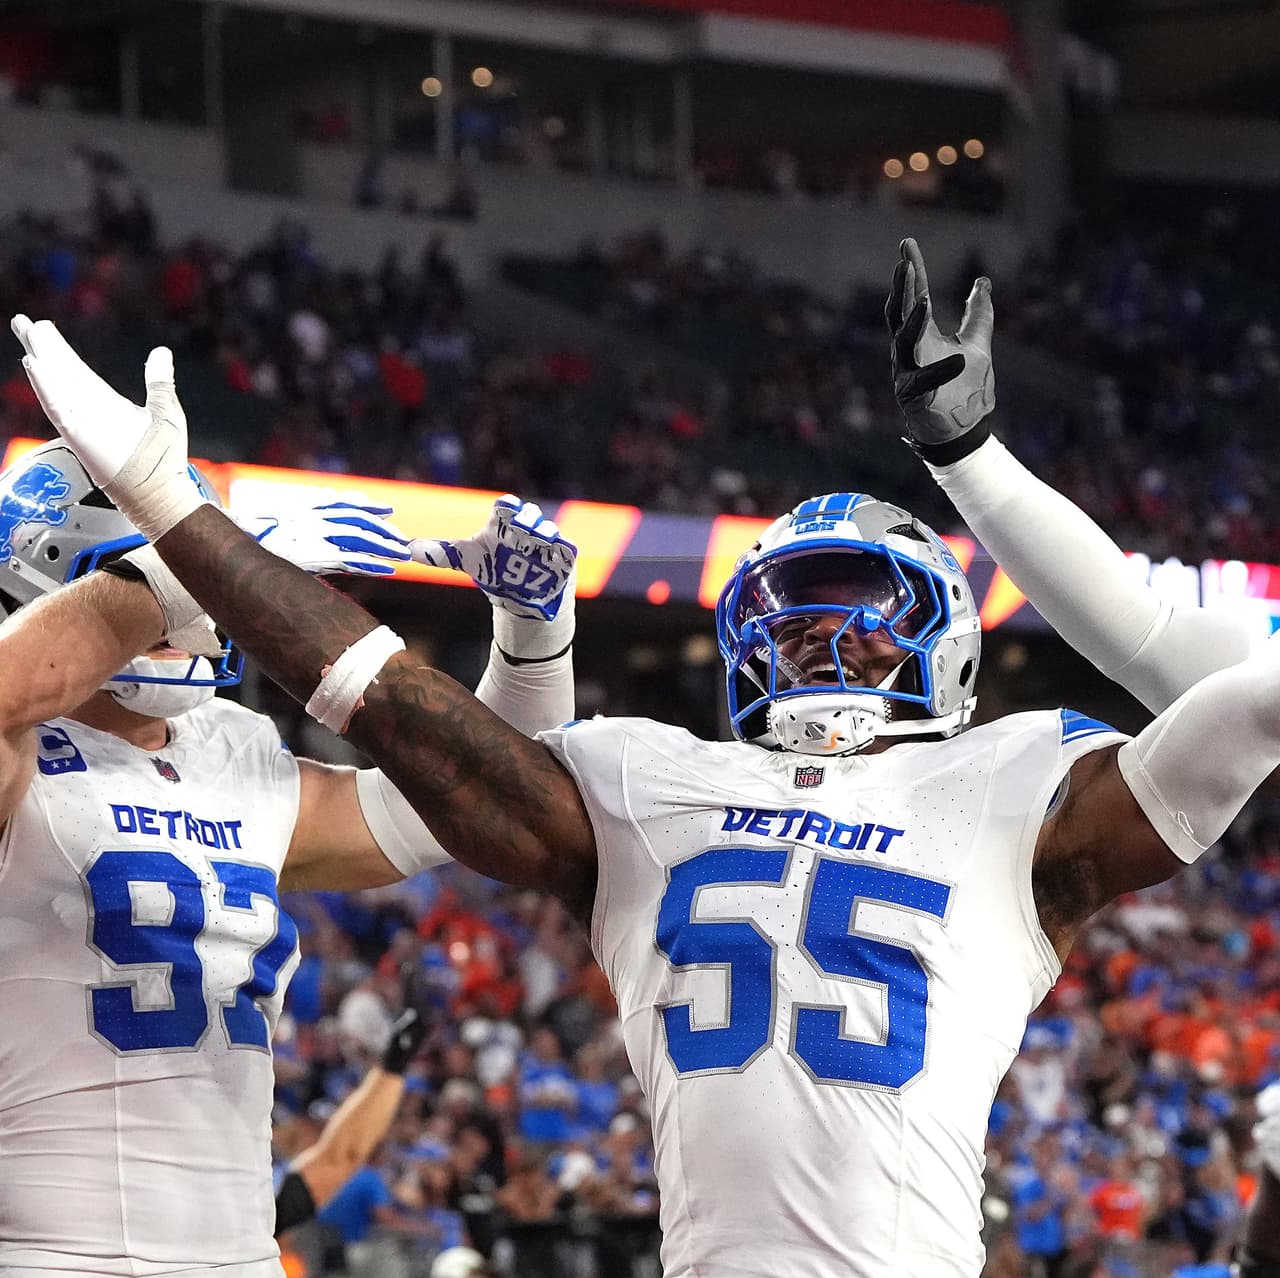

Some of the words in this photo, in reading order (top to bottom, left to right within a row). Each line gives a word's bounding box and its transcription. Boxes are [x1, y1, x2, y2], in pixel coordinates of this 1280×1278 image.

[501, 553, 553, 592] 97
[109, 804, 242, 850] DETROIT
[721, 806, 906, 854] DETROIT
[81, 846, 300, 1057] 97
[652, 842, 958, 1096] 55
